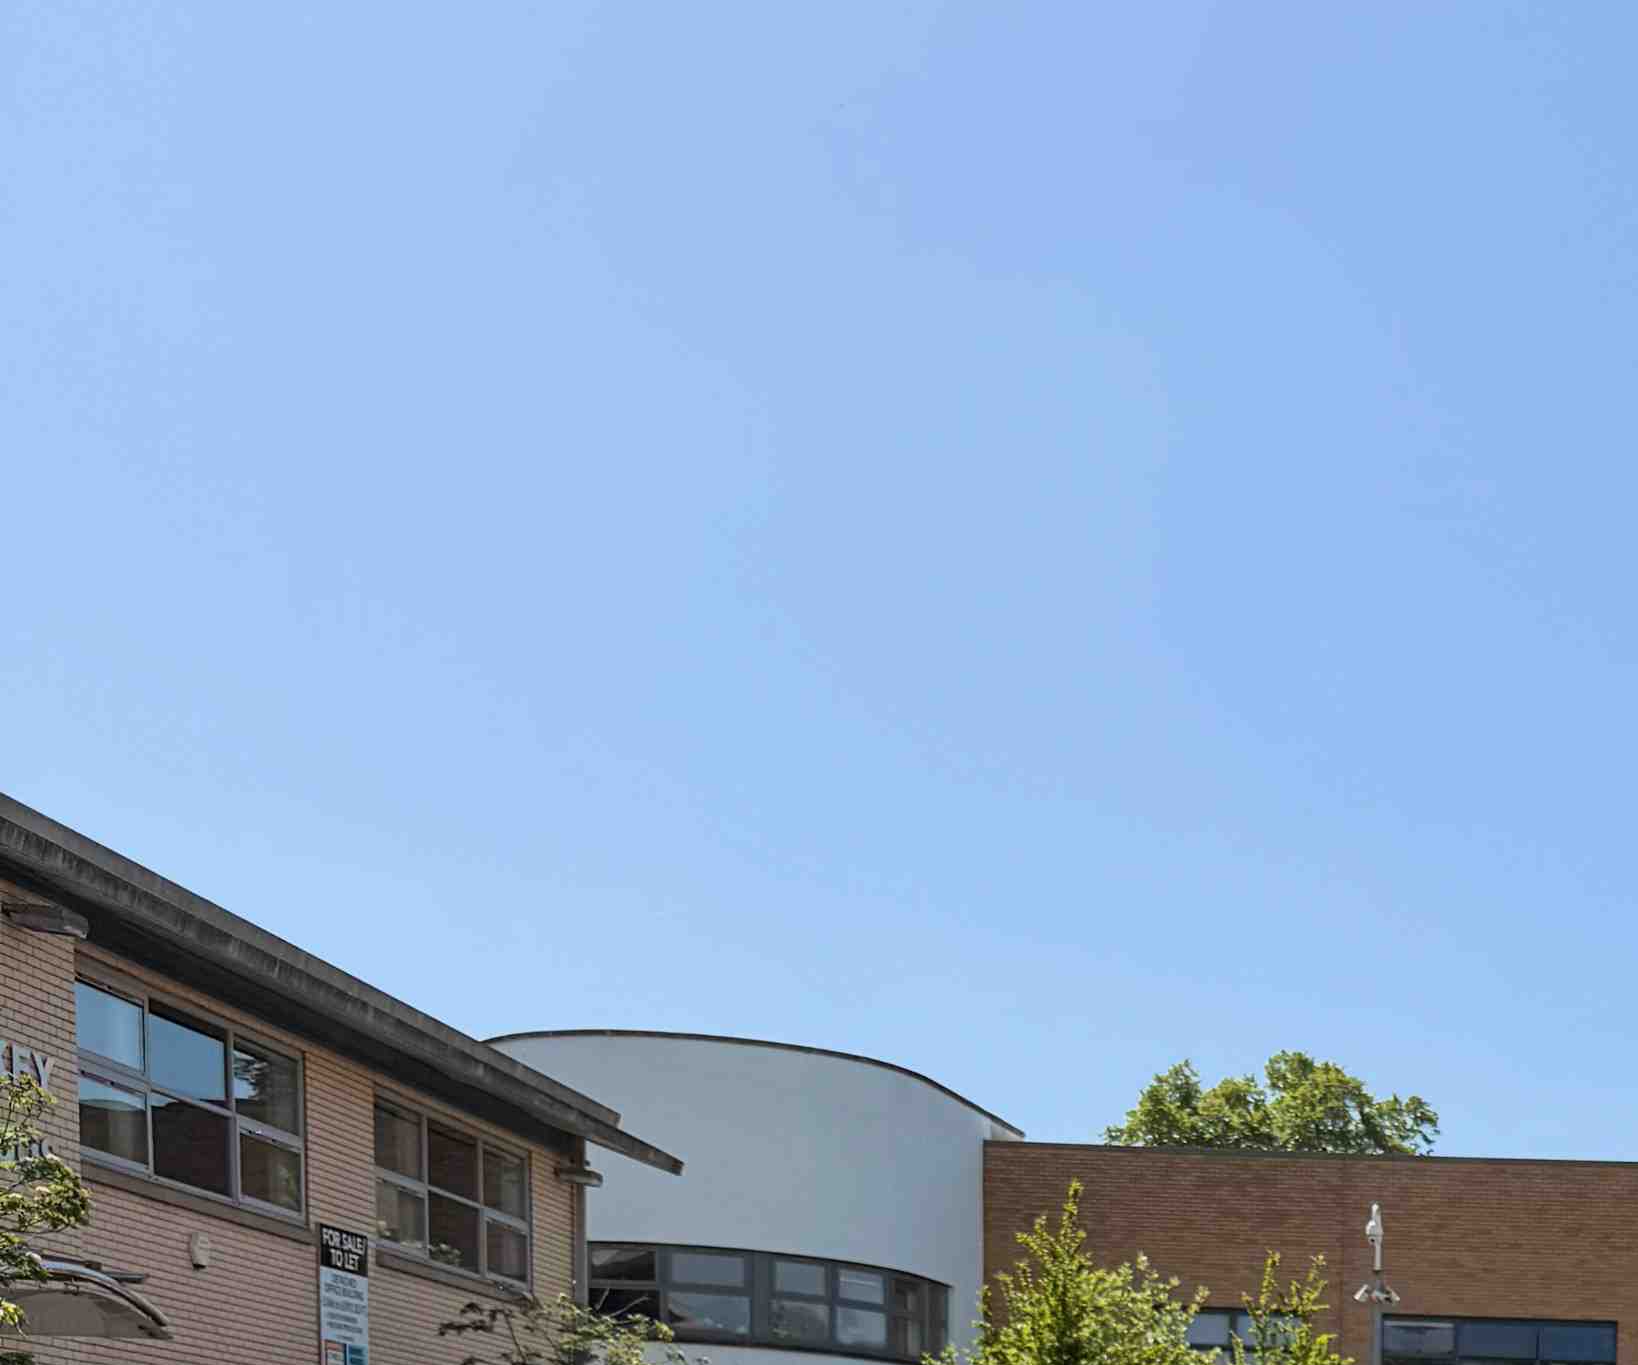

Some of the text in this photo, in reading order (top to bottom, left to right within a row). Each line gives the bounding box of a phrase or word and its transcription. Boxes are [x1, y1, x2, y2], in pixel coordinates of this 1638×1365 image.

[322, 1227, 340, 1248] FOR
[330, 1249, 359, 1271] TO LET
